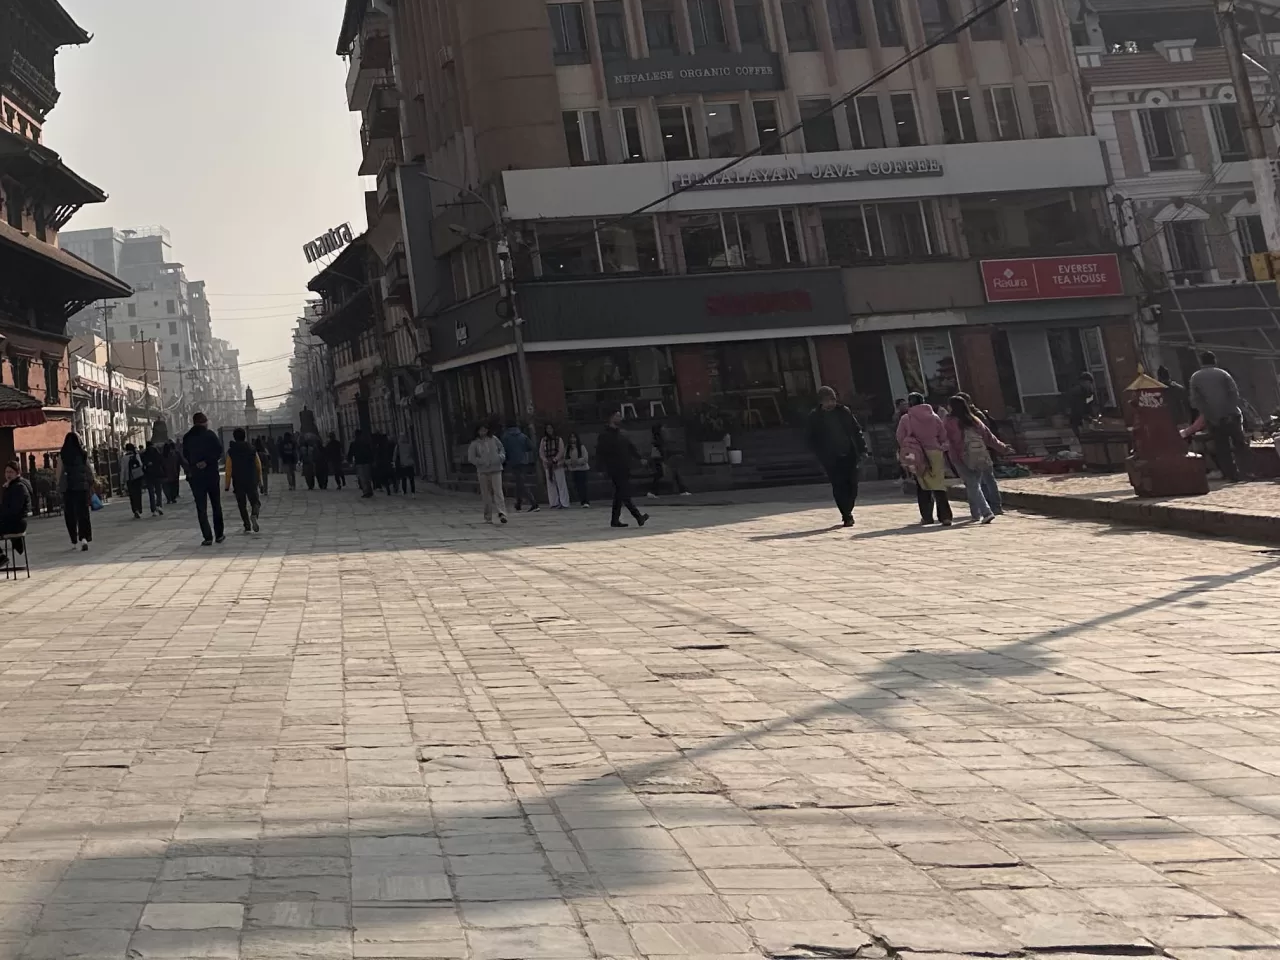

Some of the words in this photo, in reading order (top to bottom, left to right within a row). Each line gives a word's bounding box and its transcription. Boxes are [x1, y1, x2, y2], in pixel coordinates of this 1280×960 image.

[613, 70, 674, 84] NEPALESE
[679, 67, 731, 79] ORGANIC
[735, 66, 773, 76] COFFEE
[678, 166, 799, 187] HIMALAYAN
[810, 162, 860, 179] JAVA
[867, 158, 941, 176] COFFEE
[302, 222, 353, 264] mantra
[1058, 263, 1098, 274] EVEREST
[1052, 275, 1072, 285] TEA
[1073, 273, 1107, 284] HOUSE
